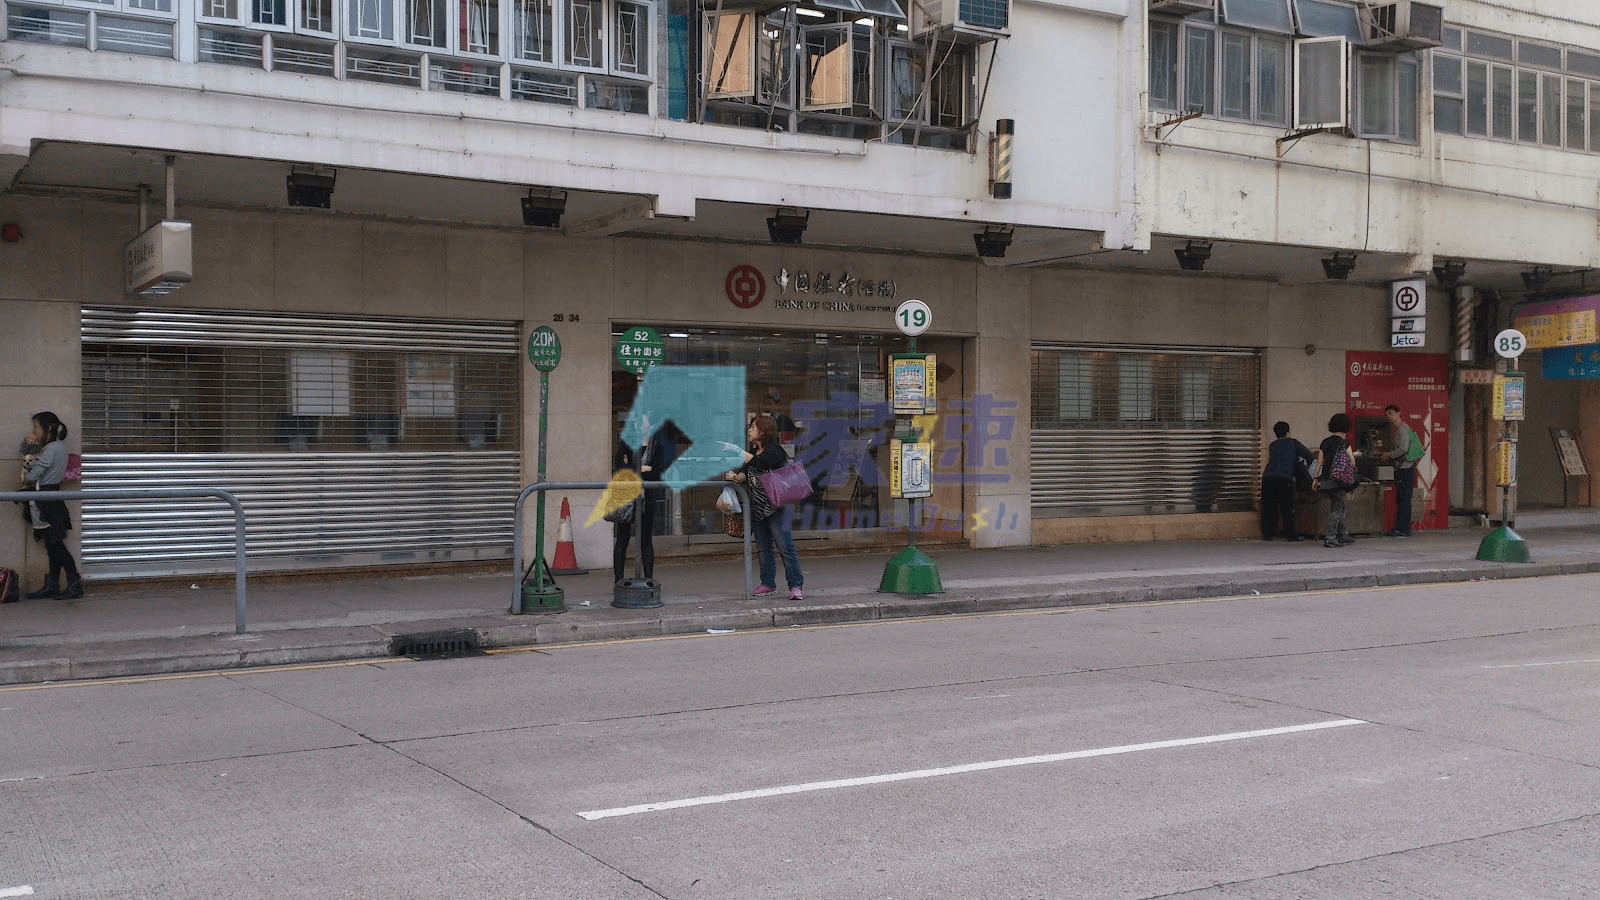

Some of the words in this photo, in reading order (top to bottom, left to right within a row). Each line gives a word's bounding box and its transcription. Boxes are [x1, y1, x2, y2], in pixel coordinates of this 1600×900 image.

[775, 299, 804, 309] BANK
[807, 300, 819, 310] OF
[822, 301, 854, 312] CHINA
[553, 314, 564, 322] 28
[569, 314, 580, 322] 34
[899, 308, 926, 327] 19
[532, 331, 556, 347] 20M
[634, 331, 649, 341] 52
[1499, 336, 1522, 352] 85
